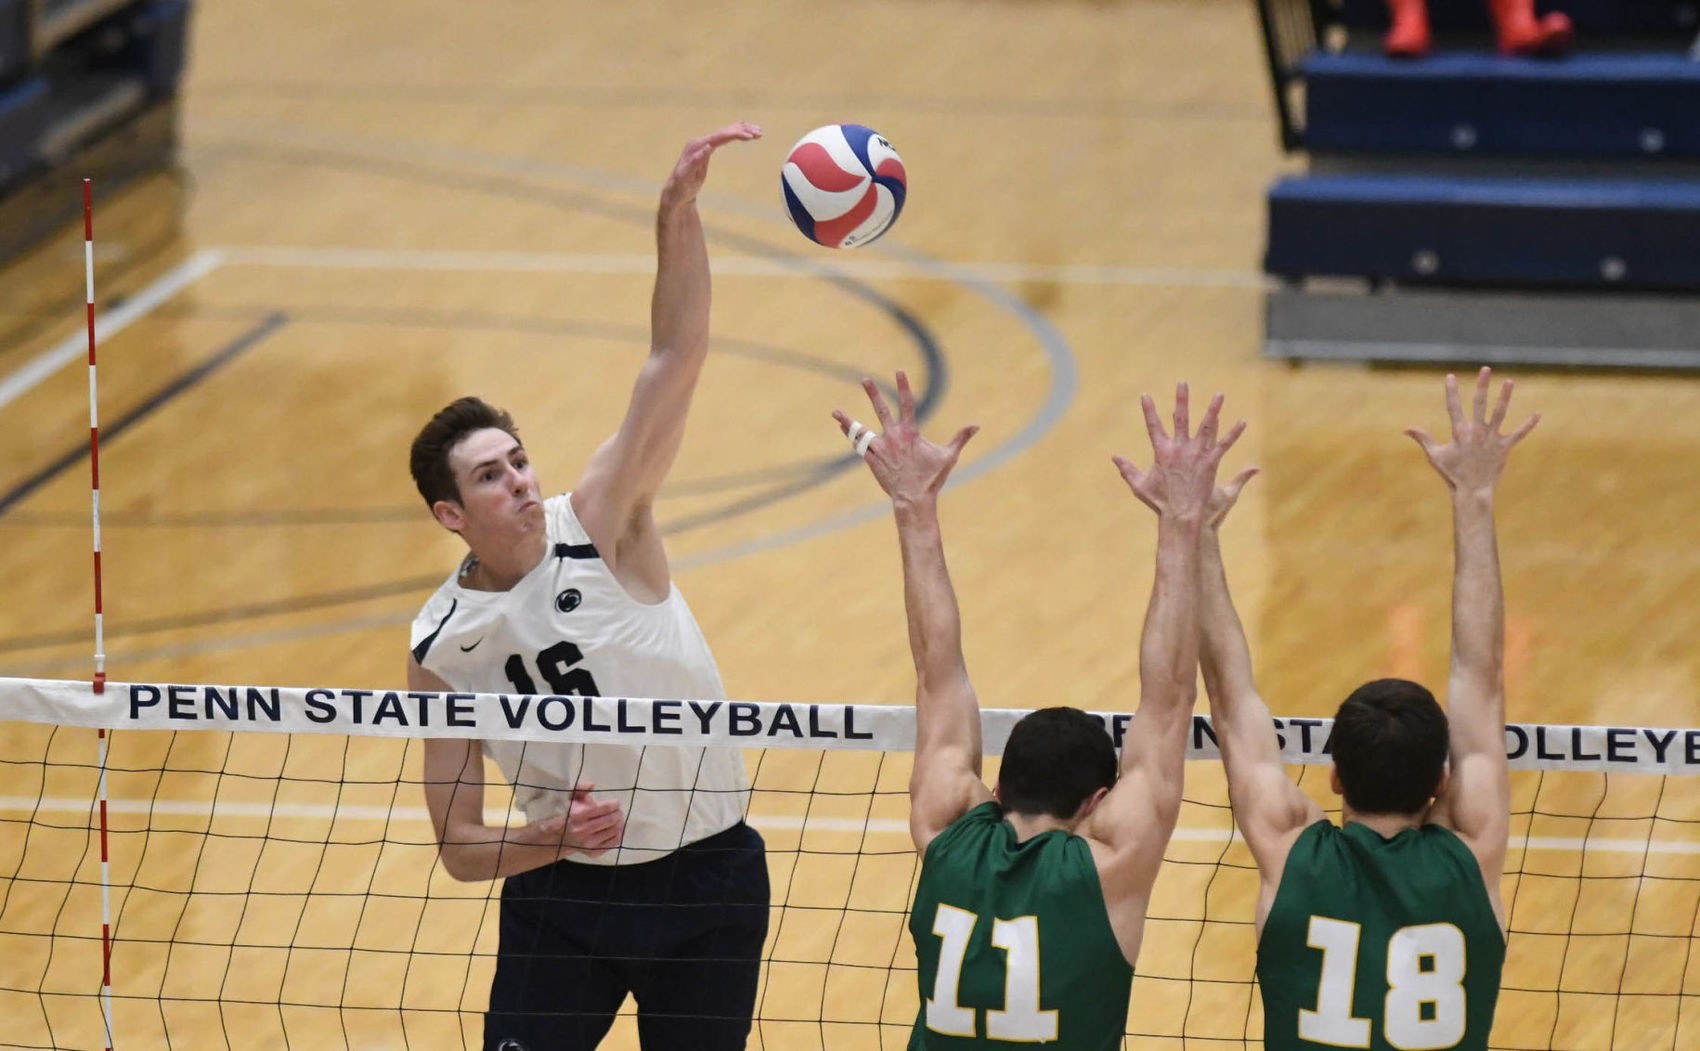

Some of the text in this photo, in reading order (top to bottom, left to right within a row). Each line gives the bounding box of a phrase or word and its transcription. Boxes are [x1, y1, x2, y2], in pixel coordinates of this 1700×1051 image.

[129, 684, 281, 721] PENN
[304, 688, 476, 727] STATE
[499, 695, 873, 740] VOLLEYBALL
[926, 902, 1059, 1043] 11
[1298, 915, 1467, 1050] 18
